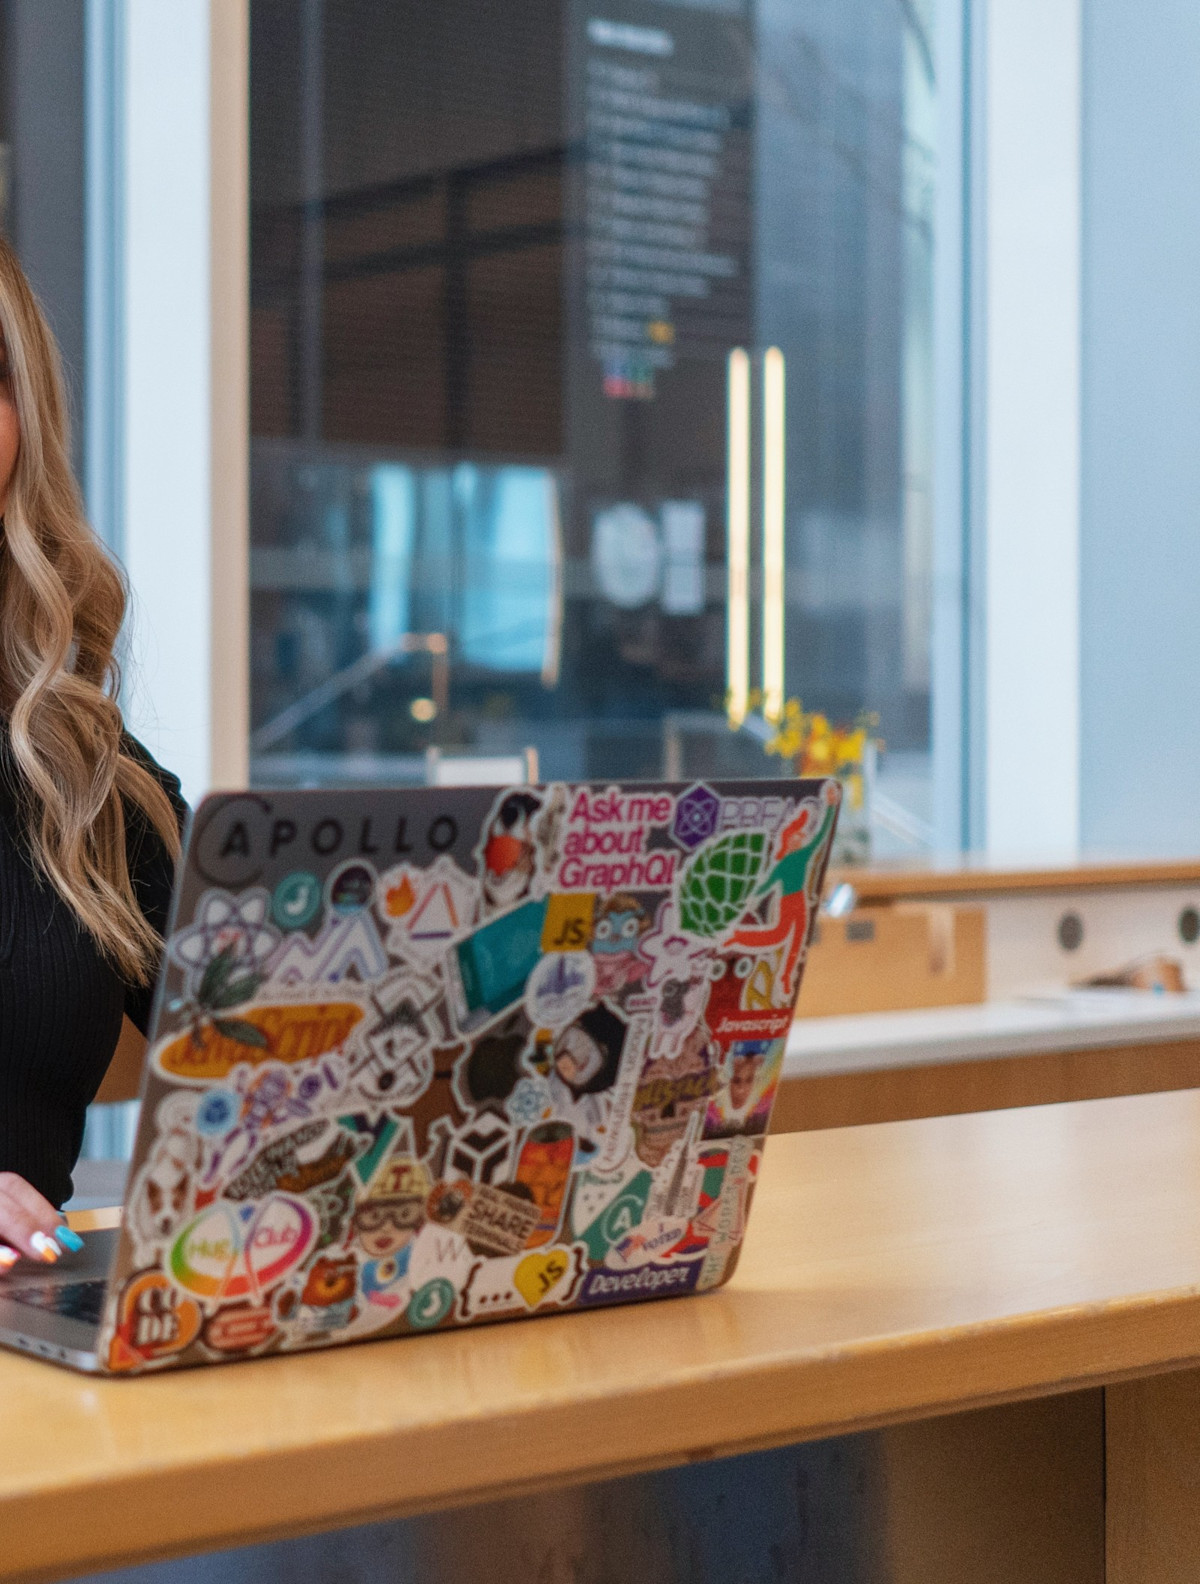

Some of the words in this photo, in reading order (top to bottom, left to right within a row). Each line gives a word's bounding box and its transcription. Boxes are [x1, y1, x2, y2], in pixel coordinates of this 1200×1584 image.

[568, 791, 623, 824] Ask
[627, 796, 671, 823] me
[219, 815, 458, 857] APOLLO
[563, 821, 645, 856] about
[553, 917, 585, 946] JS
[468, 1199, 533, 1240] SHARE
[539, 1260, 564, 1294] JS
